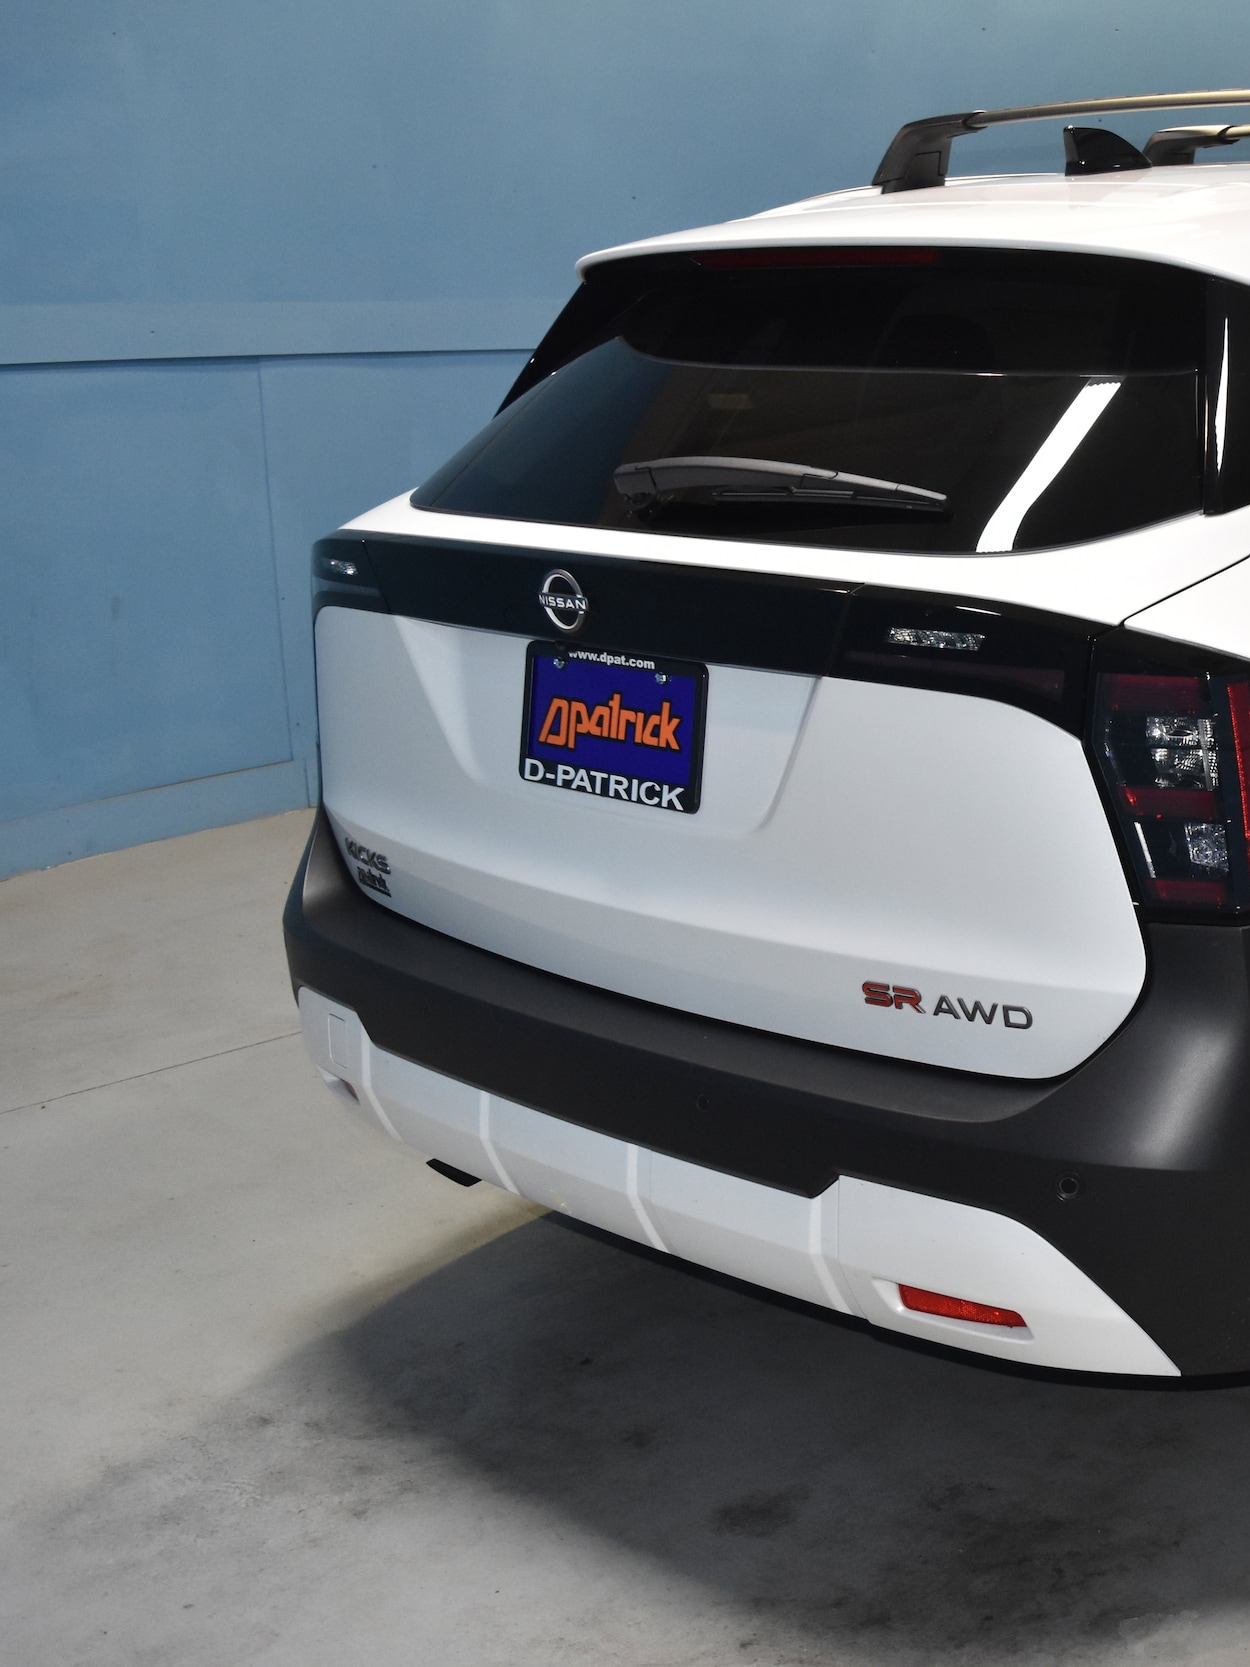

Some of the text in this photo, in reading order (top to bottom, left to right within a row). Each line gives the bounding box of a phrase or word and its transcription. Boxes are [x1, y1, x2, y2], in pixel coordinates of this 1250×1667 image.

[538, 594, 587, 610] NISSAN
[524, 757, 685, 811] D-PATRICK
[861, 980, 1033, 1030] SR AWD
